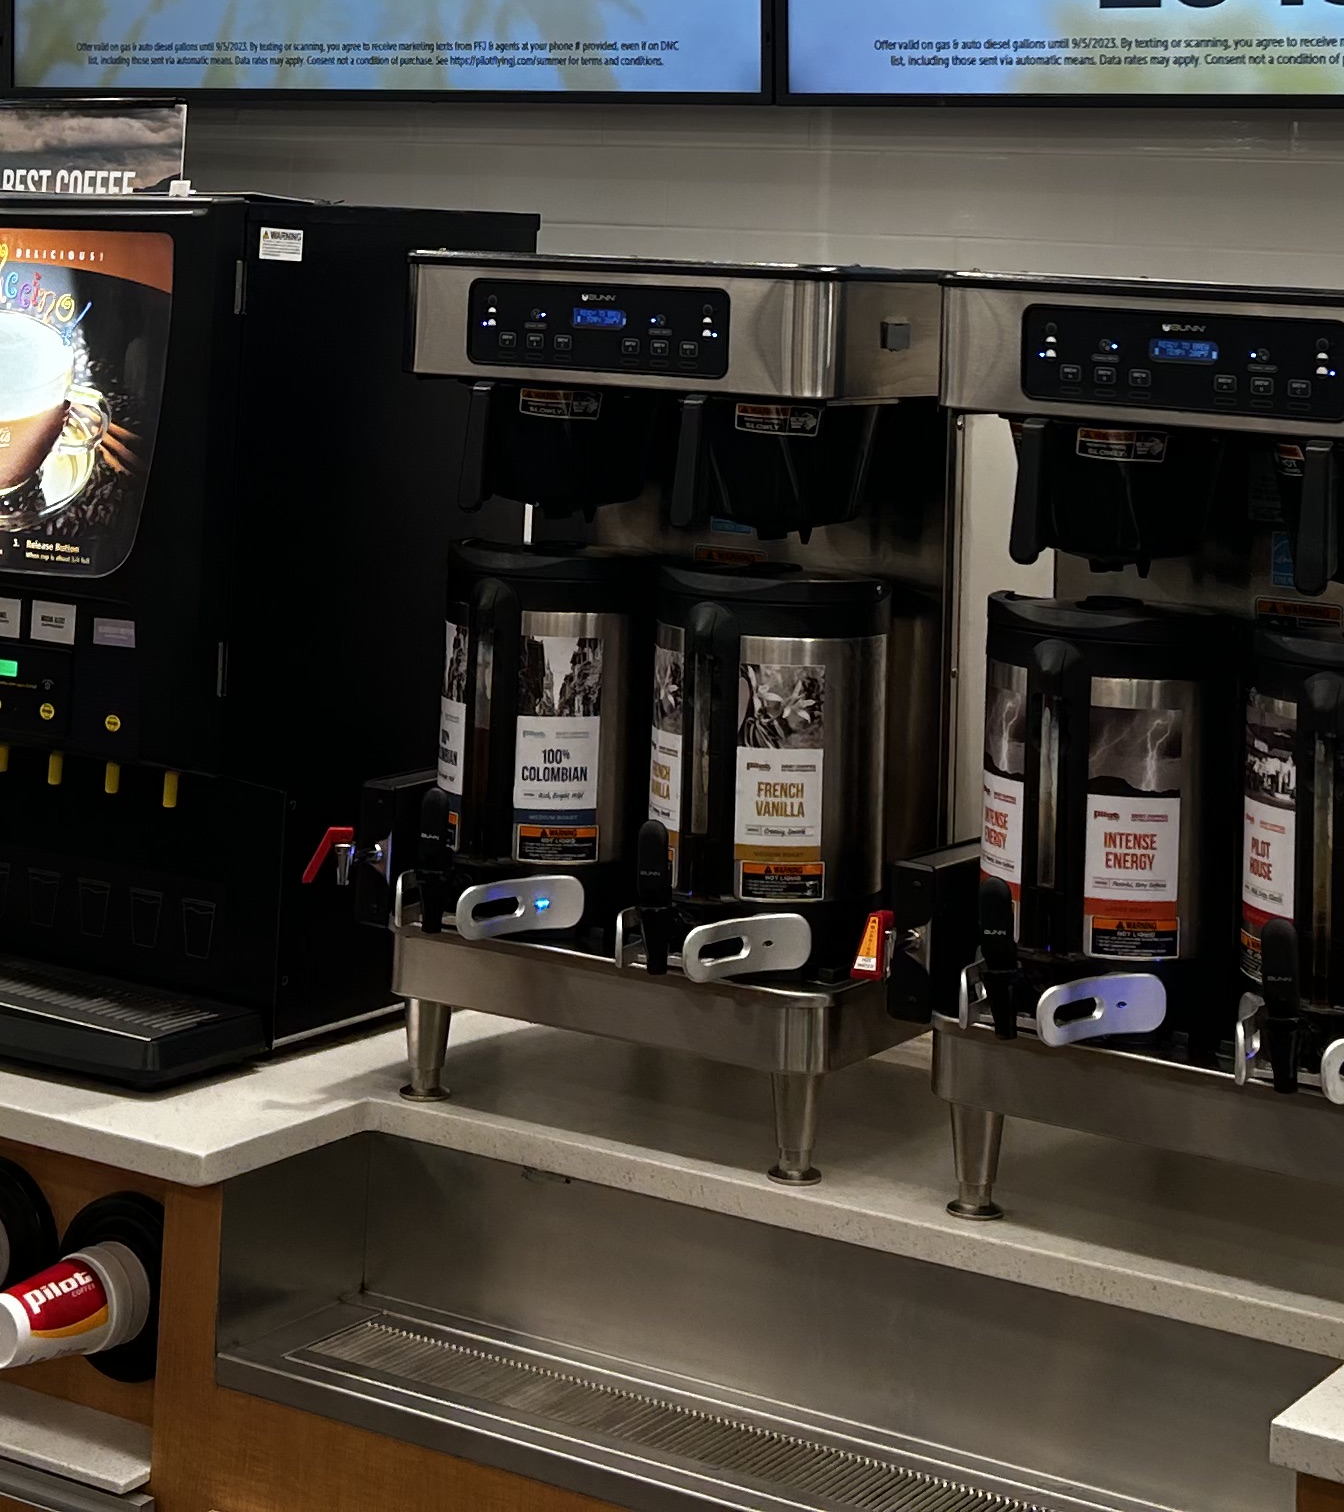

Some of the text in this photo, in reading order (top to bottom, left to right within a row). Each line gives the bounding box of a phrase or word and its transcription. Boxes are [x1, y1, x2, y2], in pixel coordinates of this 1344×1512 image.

[874, 39, 896, 49] Offer
[898, 39, 919, 49] valid
[921, 41, 933, 49] on
[936, 41, 950, 52] gas
[961, 39, 981, 49] auto
[983, 39, 1010, 49] diesel
[1012, 39, 1046, 52] gallons
[1048, 38, 1069, 48] until
[1121, 38, 1132, 50] By
[1135, 38, 1168, 50] texting
[1171, 40, 1182, 48] or
[1184, 38, 1231, 50] scanning,
[1232, 40, 1252, 50] you
[1255, 39, 1284, 50] agree
[1287, 37, 1297, 47] to
[1299, 37, 1338, 48] receive
[891, 55, 905, 66] list,
[908, 55, 949, 68] including
[951, 55, 976, 66] those
[979, 56, 997, 65] sent
[999, 55, 1013, 65] via
[1015, 55, 1062, 65] automatic
[1064, 55, 1096, 65] means.
[1099, 54, 1121, 65] Data
[1123, 54, 1147, 65] rates
[1150, 55, 1169, 67] may
[1172, 54, 1200, 67] apply.
[1205, 54, 1246, 65] Consent
[1248, 54, 1265, 65] not
[1268, 56, 1274, 64] a
[1276, 53, 1326, 64] condition
[1328, 53, 1341, 64] of
[270, 231, 302, 241] WARNING
[26, 540, 80, 554] Release Button
[542, 748, 571, 765] 100%
[522, 766, 588, 782] COLOMBIAN
[757, 782, 805, 799] FRENCH
[755, 801, 805, 818] VANILLA
[1103, 832, 1157, 851] INTENSE
[1251, 836, 1271, 860] PILOT
[1106, 852, 1155, 871] ENERGY
[1249, 858, 1273, 882] HOUSE
[1125, 921, 1157, 930] WARNING
[22, 1271, 94, 1315] pilot
[71, 1283, 96, 1299] COFFEE
